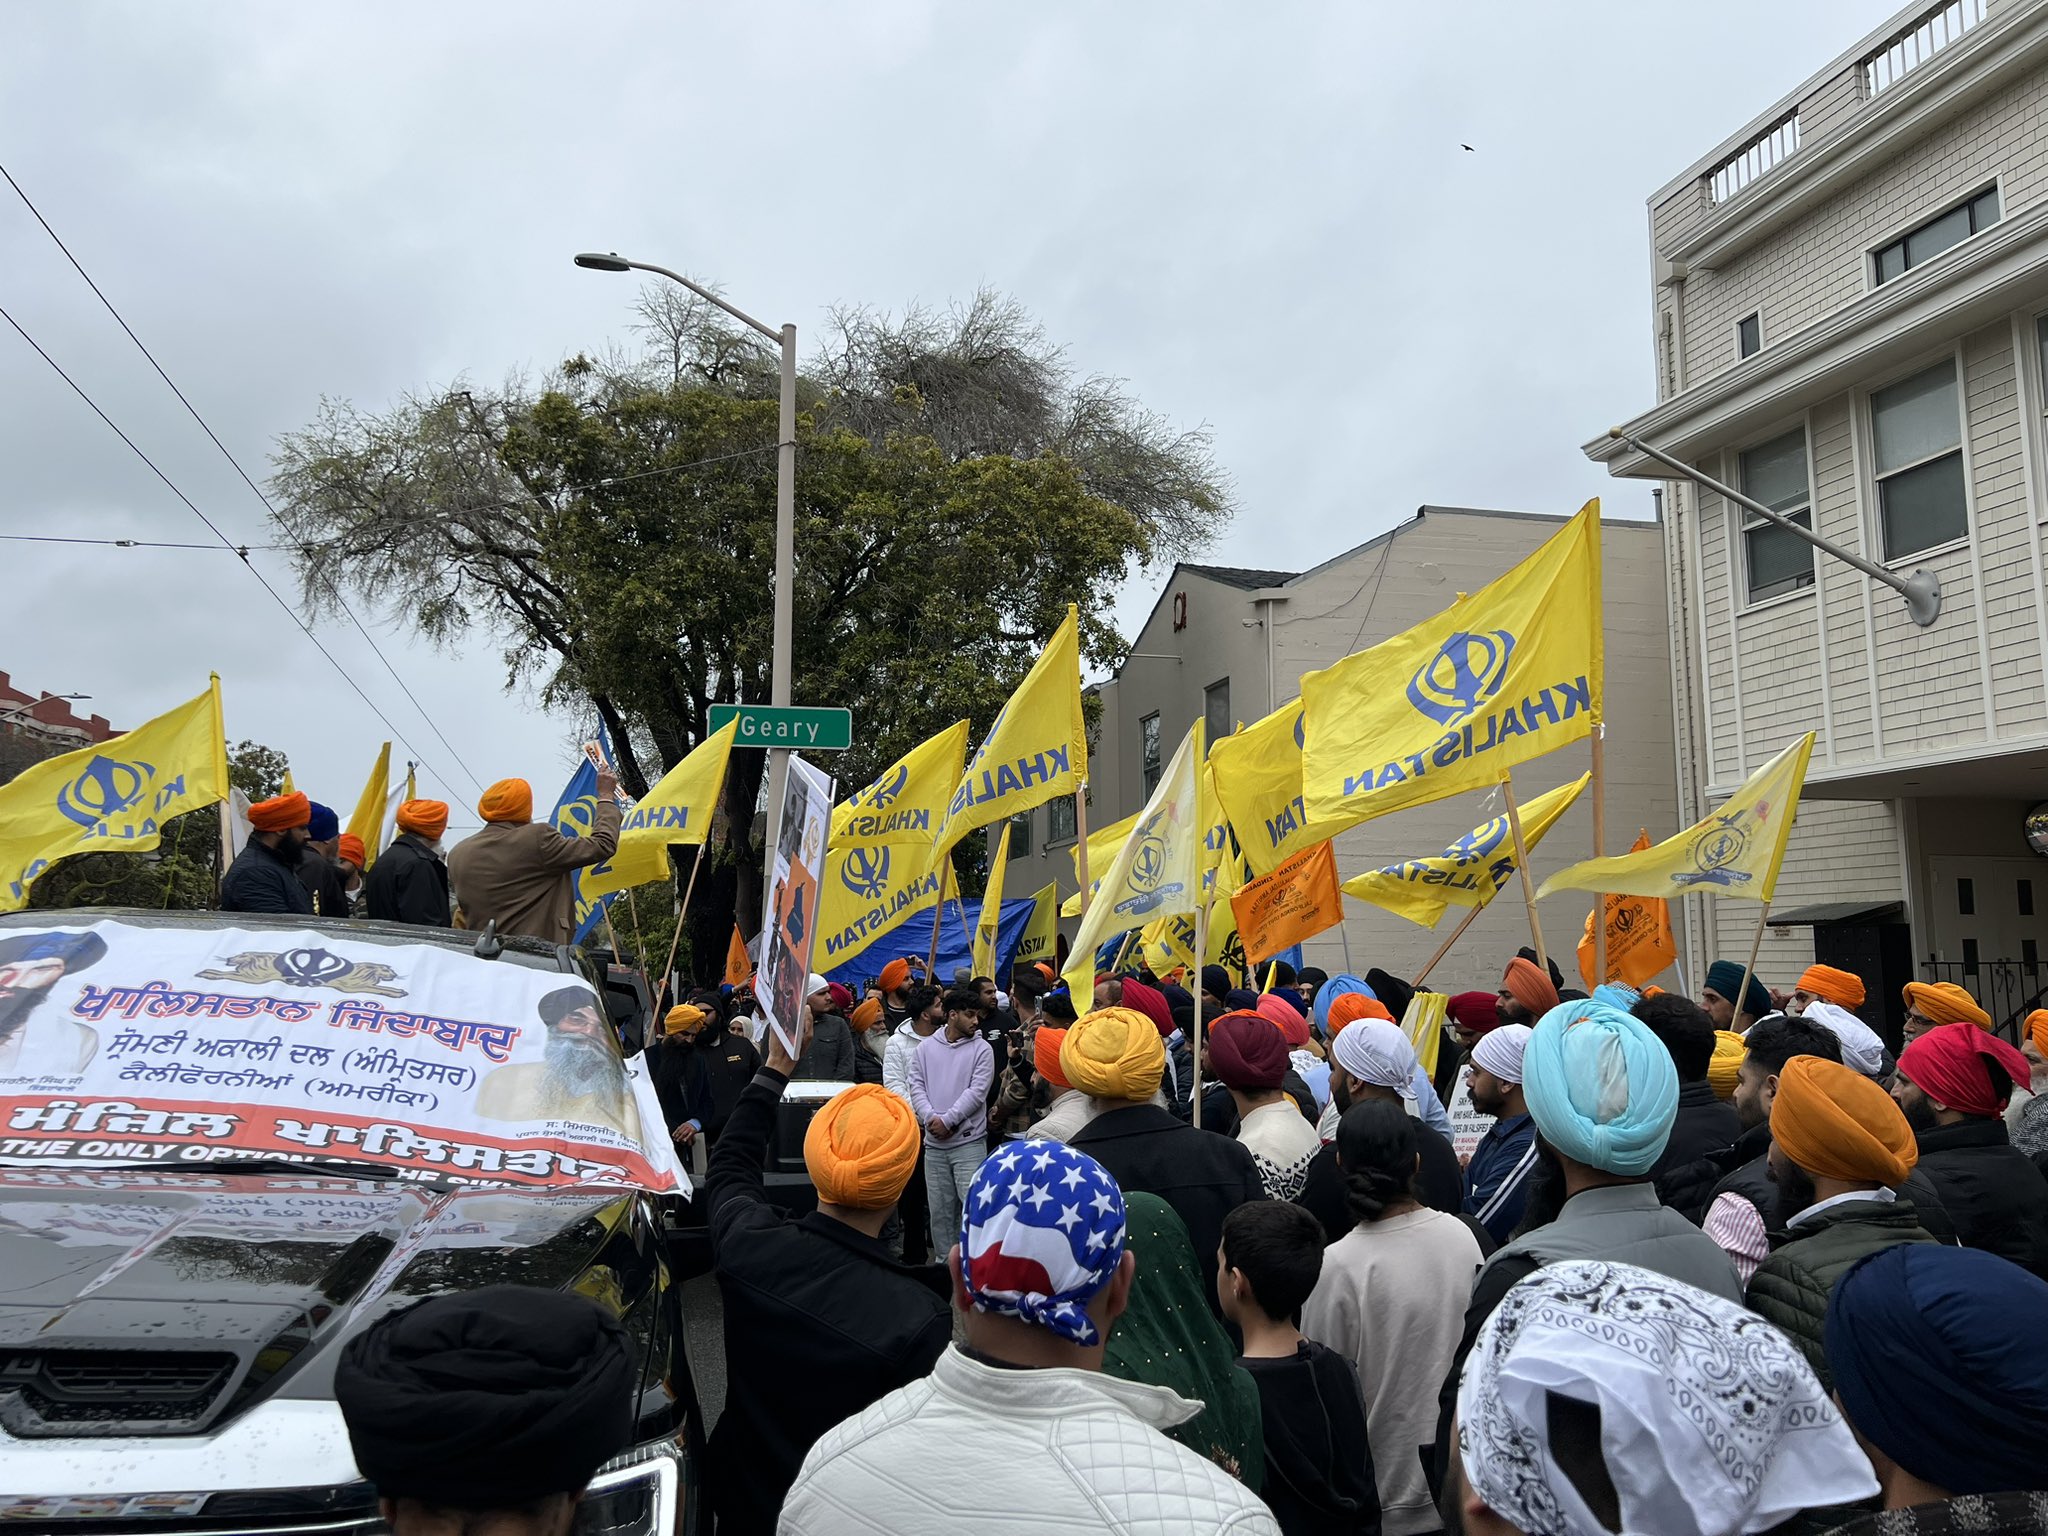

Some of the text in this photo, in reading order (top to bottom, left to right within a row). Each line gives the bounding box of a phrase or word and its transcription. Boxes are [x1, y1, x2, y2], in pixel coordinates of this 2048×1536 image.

[740, 715, 821, 743] Geary
[71, 980, 522, 1063] ਖਾਲਿਸਤਾਨ ਜਿੰਦਾਬਾਦ
[193, 1035, 283, 1062] ਅਕਾਲੀ
[290, 1044, 336, 1067] ਦਲ
[304, 1077, 439, 1112] (ਅਮਰੀਕਾ)
[2, 1139, 76, 1156] THE
[77, 1141, 178, 1159] ONLY
